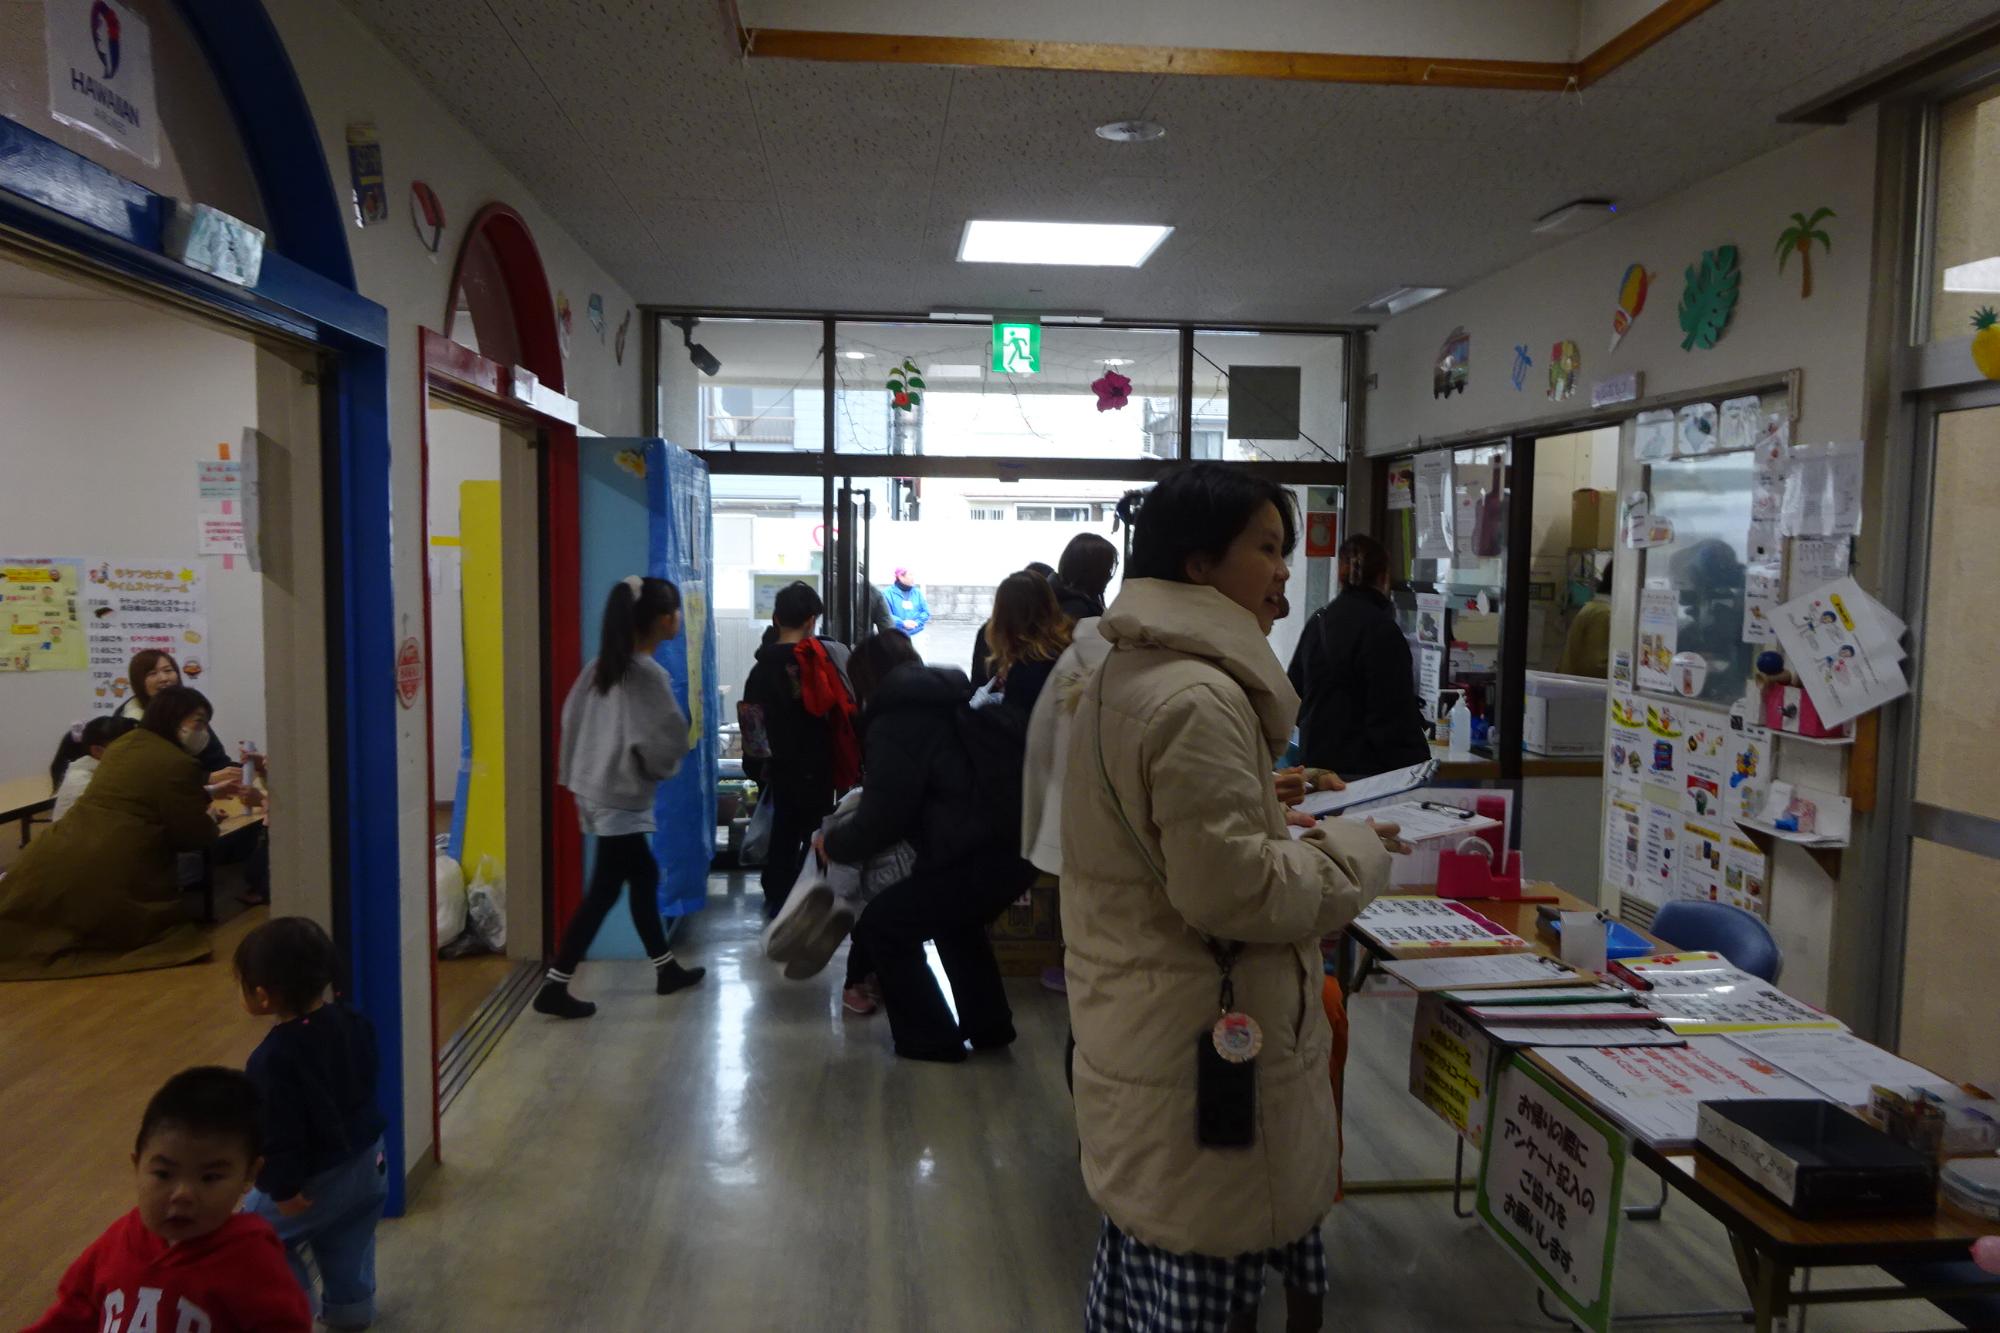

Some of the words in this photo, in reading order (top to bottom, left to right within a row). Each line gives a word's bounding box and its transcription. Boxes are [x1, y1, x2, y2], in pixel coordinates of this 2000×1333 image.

[70, 67, 140, 128] HAWAIIAN
[1517, 1093, 1589, 1168] お帰りの際に
[1504, 1118, 1596, 1215] アンケート記入の
[1519, 1169, 1568, 1230] ご協力を
